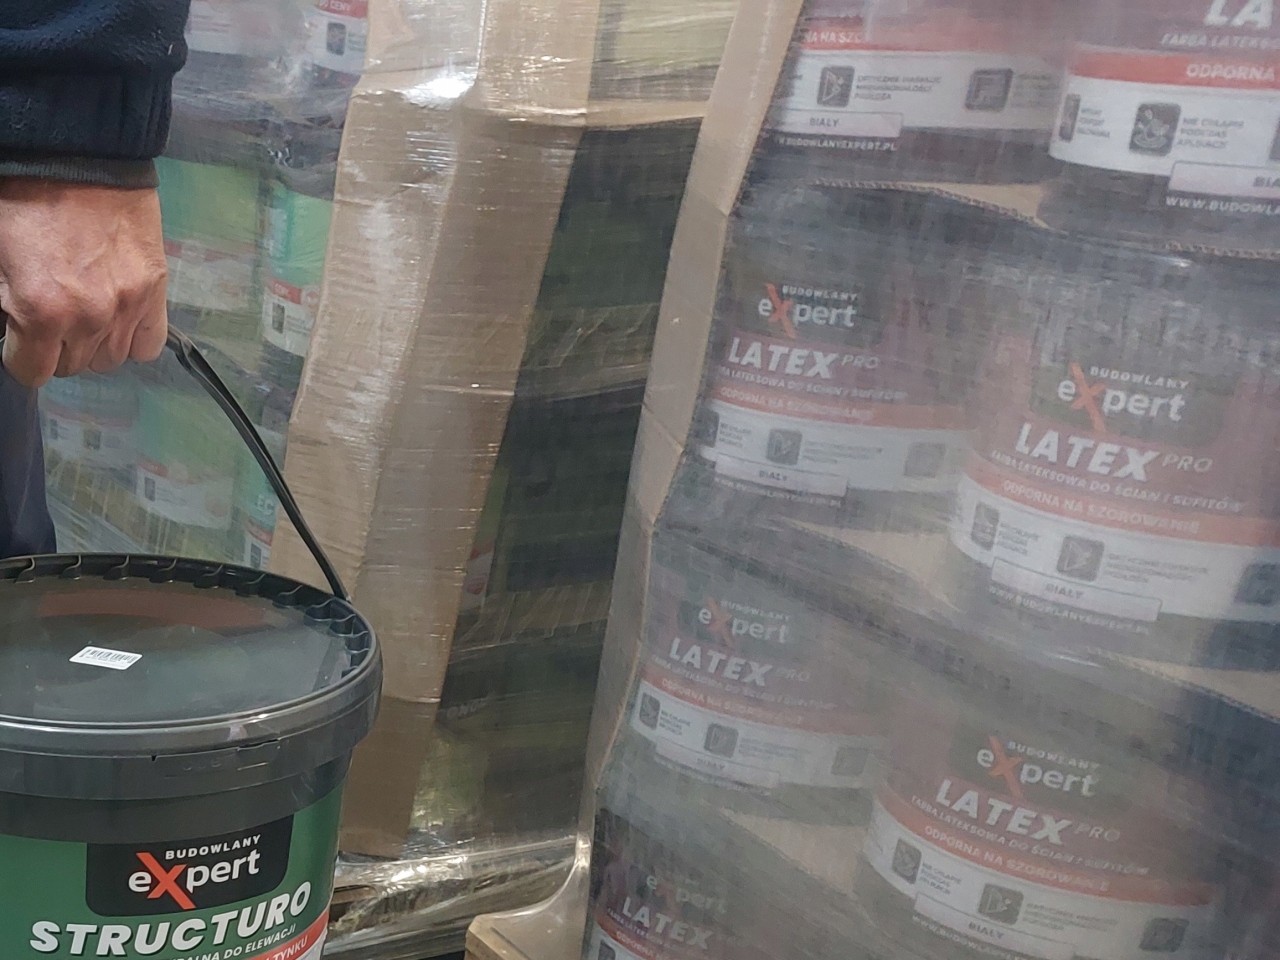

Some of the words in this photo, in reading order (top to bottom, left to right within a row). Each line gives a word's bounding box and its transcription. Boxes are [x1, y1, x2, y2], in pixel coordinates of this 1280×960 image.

[1186, 64, 1275, 81] ODPORNA
[728, 337, 840, 379] LATEX
[841, 354, 880, 369] PRO
[1090, 366, 1189, 389] BUDOWLANY
[1015, 423, 1160, 482] LATEX
[1161, 453, 1214, 473] PRO
[670, 637, 773, 687] LATEX
[935, 779, 1072, 846] LATEX
[1074, 823, 1121, 843] PRO
[165, 834, 261, 860] BUDOWLANY
[29, 881, 312, 956] STRUCTURO
[223, 945, 243, 960] DO
[244, 923, 297, 955] ELEWACJI
[622, 896, 714, 949] LATEX
